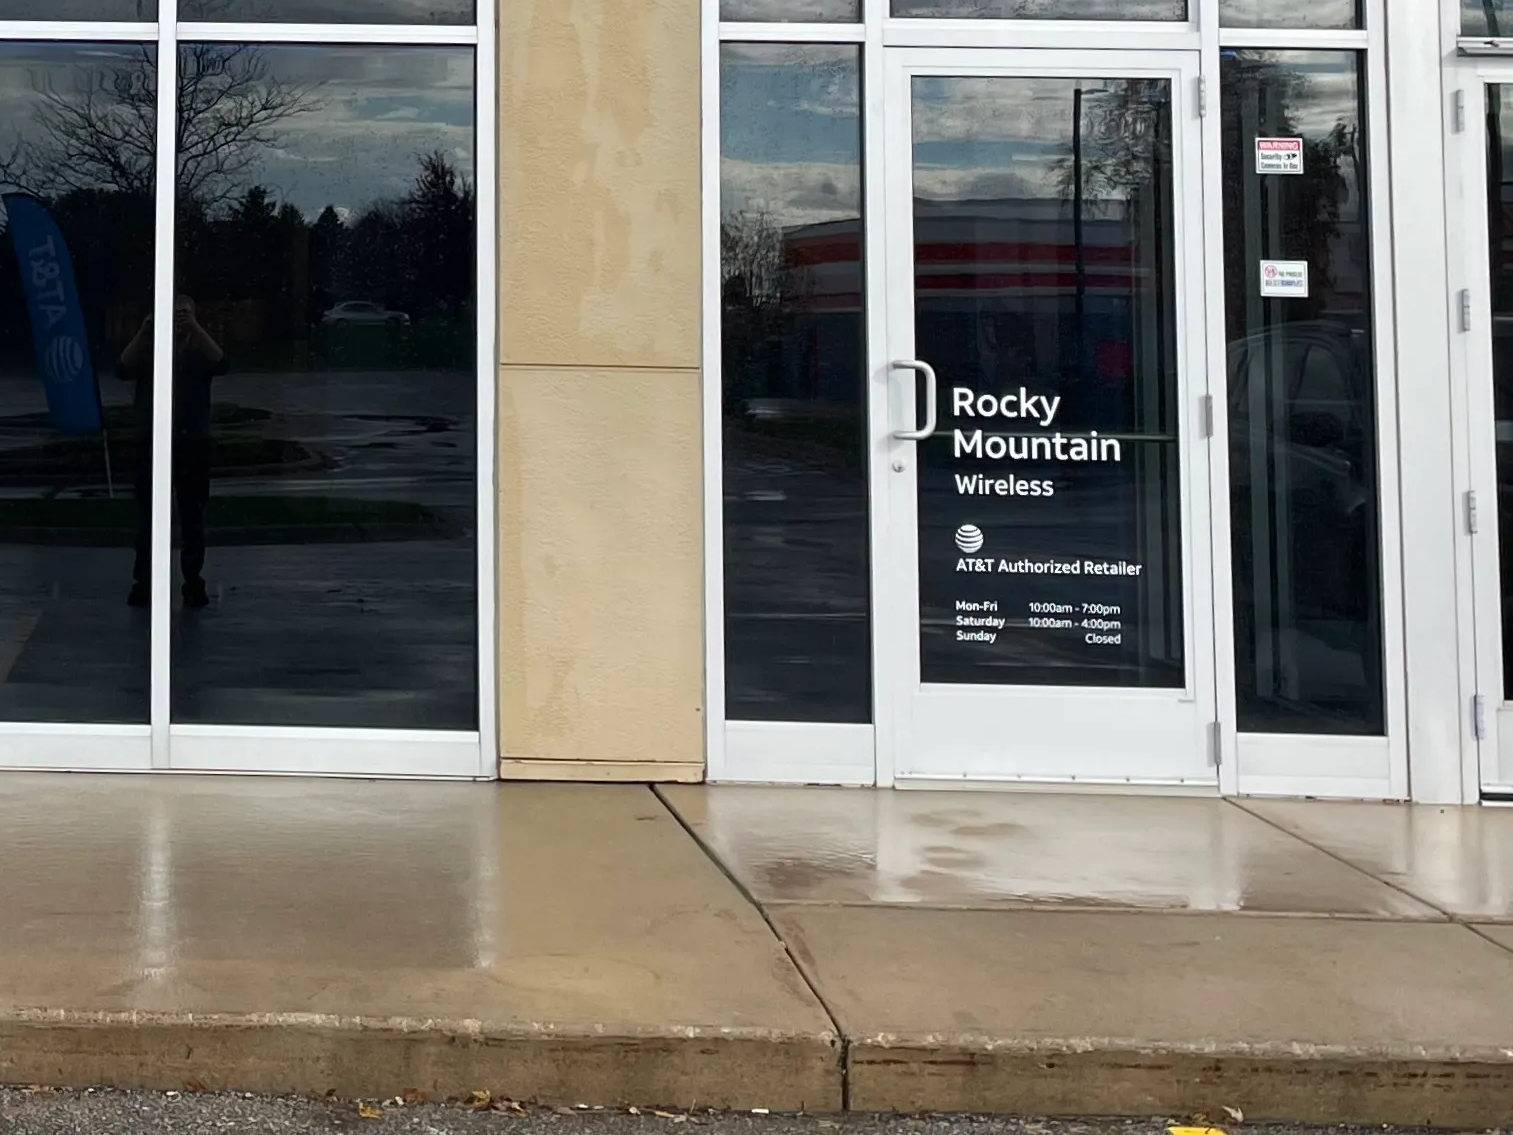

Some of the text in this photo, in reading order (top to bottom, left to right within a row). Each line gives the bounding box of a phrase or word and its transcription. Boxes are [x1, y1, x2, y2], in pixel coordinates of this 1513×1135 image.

[1259, 141, 1299, 150] WARNING
[952, 387, 1061, 427] Rocky
[953, 429, 1122, 462] Mountain
[954, 473, 1055, 497] Wireless
[955, 558, 1143, 576] AT&T Authorized Retailer
[955, 600, 998, 612] Mon-Fri
[1028, 602, 1073, 614] 10:00am
[1081, 603, 1121, 616] 7:00pm
[955, 615, 1006, 629] Saturday
[1028, 617, 1073, 629] 10:00am
[1080, 618, 1122, 631] 4:00pm
[956, 630, 1122, 645] Sunday Closed
